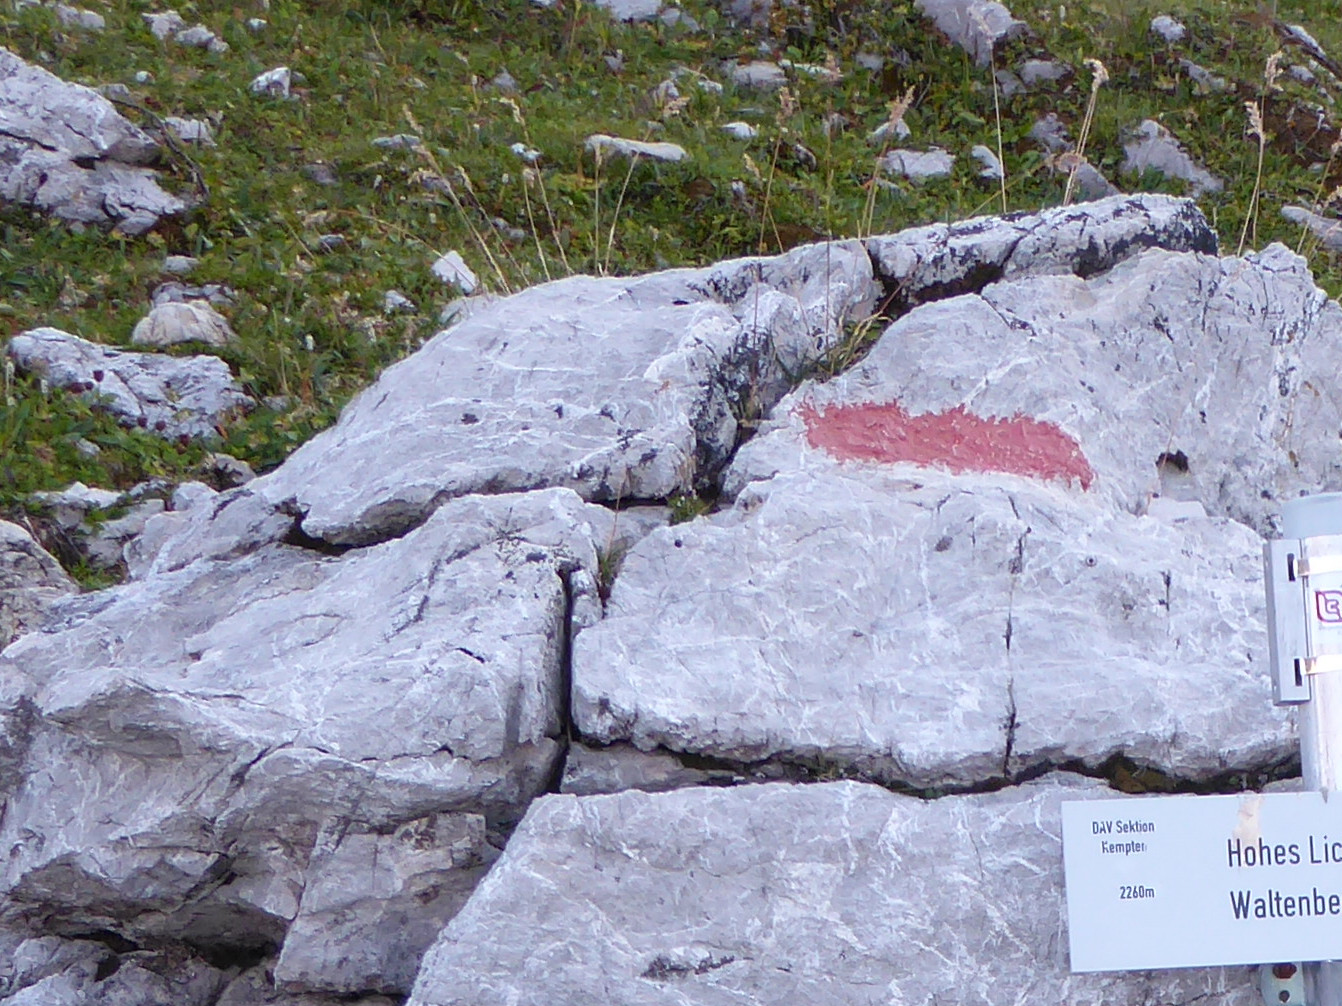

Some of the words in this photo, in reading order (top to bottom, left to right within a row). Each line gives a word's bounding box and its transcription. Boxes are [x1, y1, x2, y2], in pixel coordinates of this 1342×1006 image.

[1092, 821, 1113, 835] DAV
[1116, 820, 1155, 834] Sektion
[1227, 837, 1301, 867] Hohes
[1119, 885, 1155, 900] 2260m
